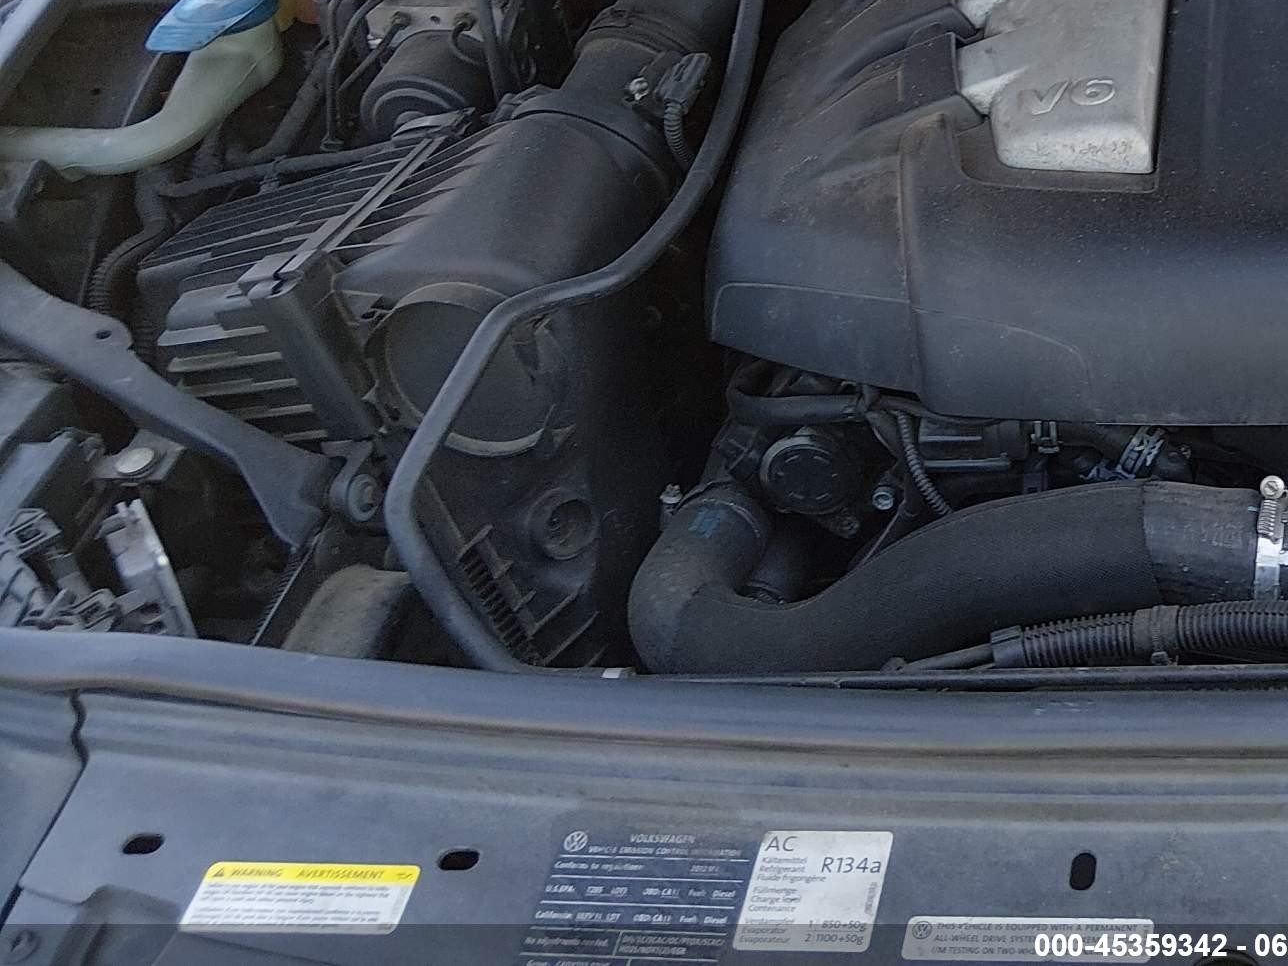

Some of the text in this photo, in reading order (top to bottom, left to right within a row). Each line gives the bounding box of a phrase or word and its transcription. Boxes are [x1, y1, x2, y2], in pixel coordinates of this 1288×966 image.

[1017, 78, 1116, 115] V6
[629, 834, 697, 844] VOLKSWAGEN
[764, 835, 797, 852] AC
[821, 856, 882, 874] R134a
[230, 867, 385, 880] WARNING AVERTISSEMENT
[750, 895, 780, 904] Charge
[1005, 923, 1048, 932] EQUIPPED
[1050, 924, 1075, 932] WITH
[1085, 924, 1138, 932] PERMANENT
[934, 935, 980, 943] ALL-WHEEL
[982, 935, 1006, 943] DRIVE
[949, 946, 980, 955] TESTING
[982, 947, 994, 955] ON
